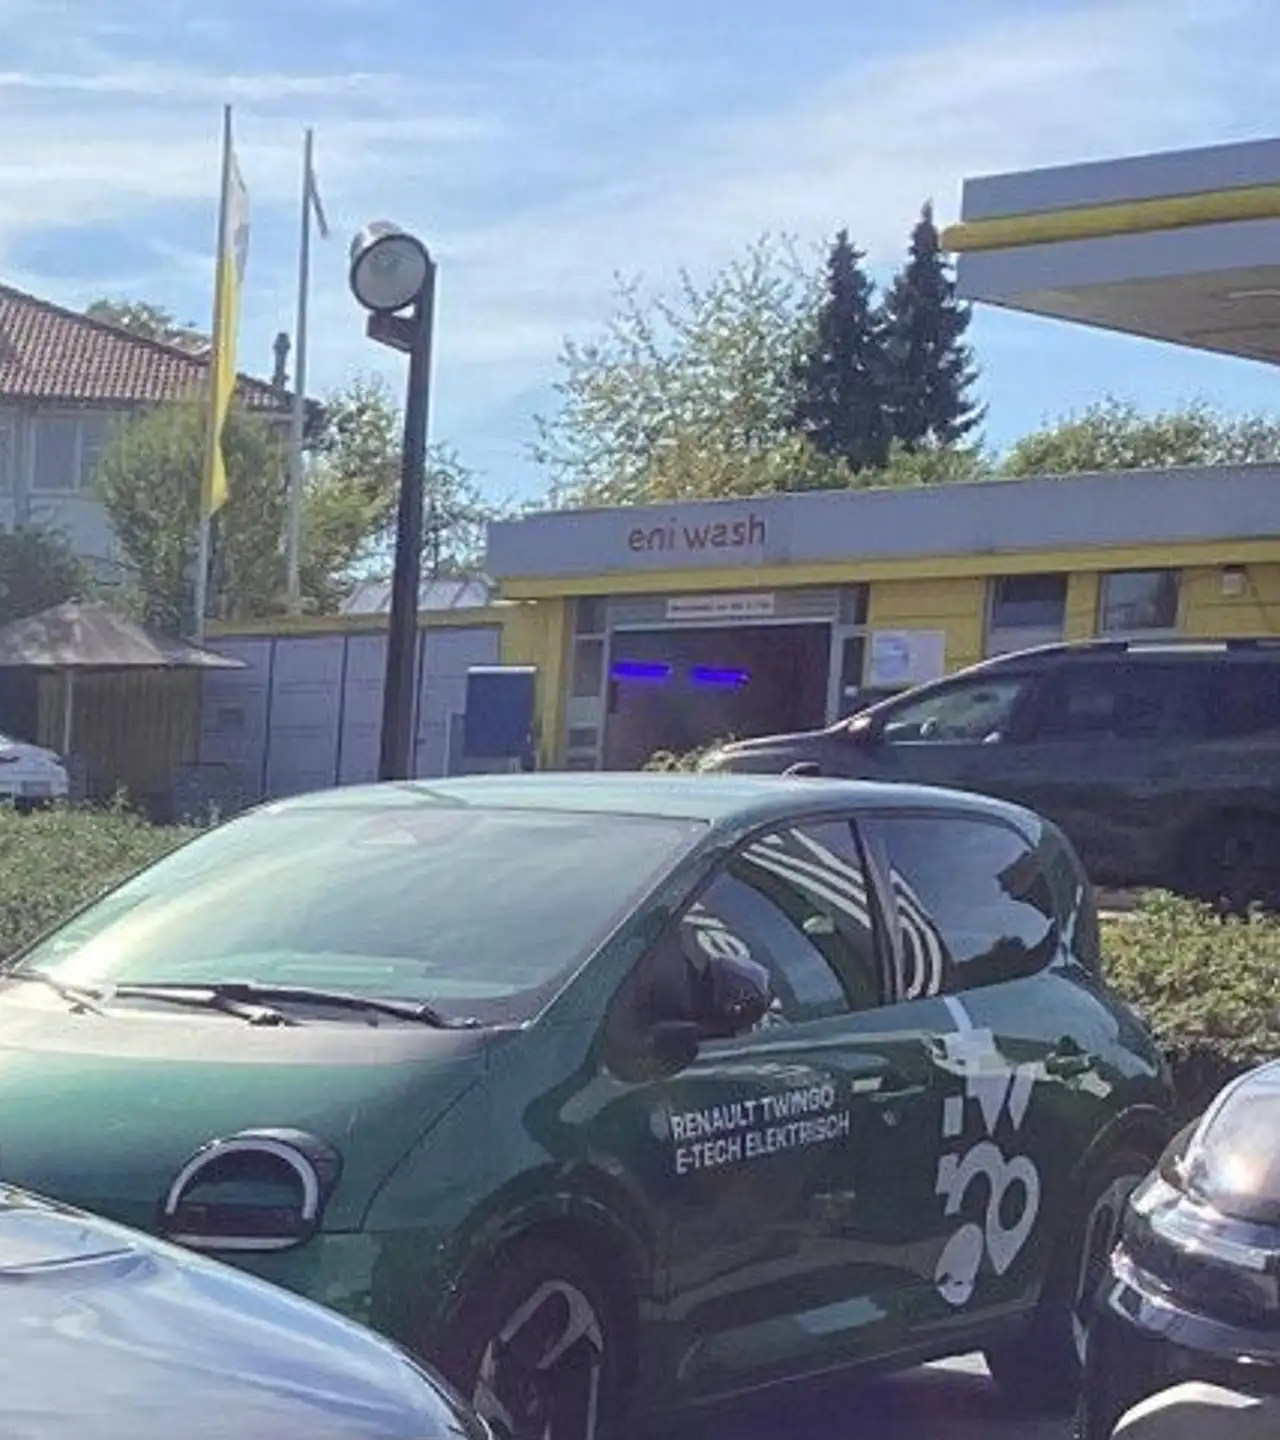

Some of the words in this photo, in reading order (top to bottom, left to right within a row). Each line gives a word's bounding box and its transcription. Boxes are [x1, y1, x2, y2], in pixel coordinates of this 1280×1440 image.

[628, 516, 677, 552] eni
[684, 513, 766, 549] wash
[670, 1101, 757, 1140] RENAULT
[760, 1085, 835, 1121] TWINGO
[676, 1136, 741, 1174] E-TECH
[745, 1110, 850, 1157] ELEKTRISCH
